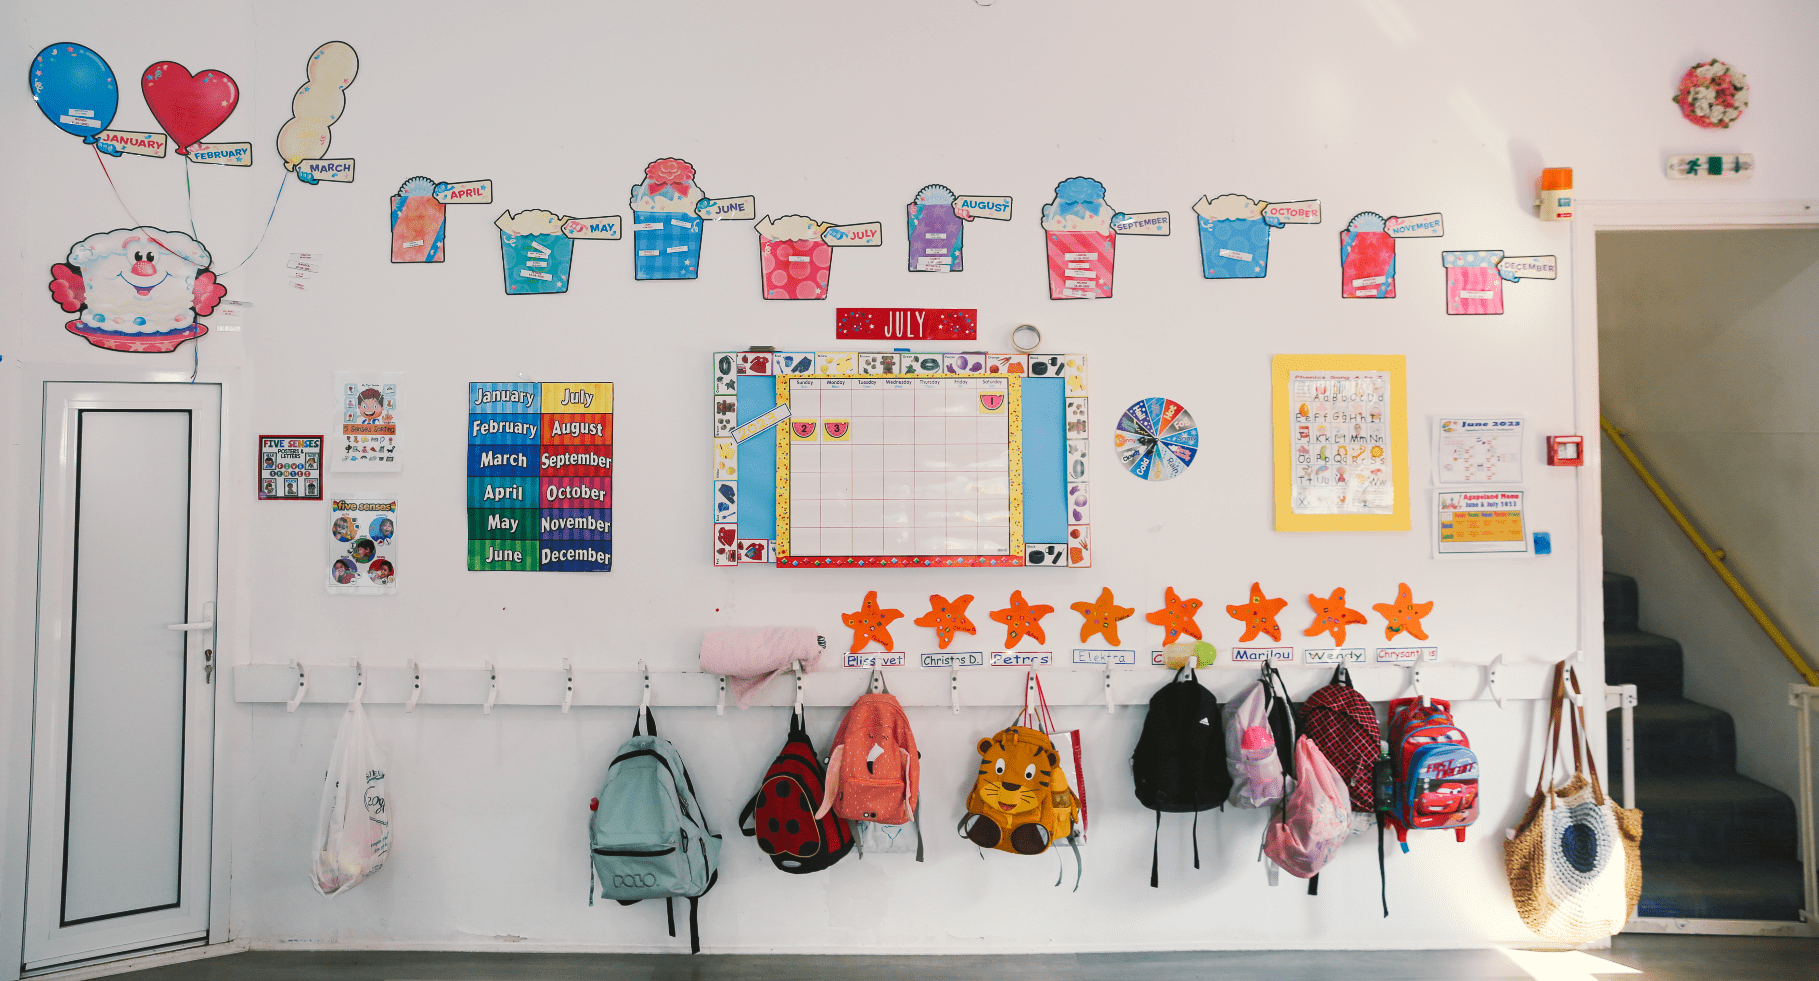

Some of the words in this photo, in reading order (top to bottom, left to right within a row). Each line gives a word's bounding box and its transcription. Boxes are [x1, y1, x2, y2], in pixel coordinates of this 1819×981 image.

[103, 134, 164, 149] JANUARY
[194, 148, 248, 160] FEBRUARY
[310, 164, 350, 173] MARCH
[450, 188, 482, 199] APRIL
[715, 203, 745, 215] JUNE
[961, 200, 1009, 212] AUGUST
[1270, 208, 1318, 218] OCTOBER
[590, 224, 614, 233] MAY
[1116, 217, 1168, 231] SEPTEMBER
[1393, 220, 1440, 234] NOVEMBER
[850, 230, 877, 240] JULY
[1504, 262, 1554, 272] DECEMBER
[884, 311, 926, 337] JULY
[475, 388, 535, 407] January
[561, 389, 594, 408] July
[991, 397, 993, 405] 1
[1133, 405, 1147, 420] Hail
[1164, 405, 1177, 420] Hot
[374, 425, 395, 433] Sorting
[472, 419, 537, 439] February
[552, 420, 603, 437] August
[739, 412, 777, 440] 2023
[1174, 416, 1191, 430] Fog
[480, 450, 527, 468] March
[541, 452, 612, 470] September
[1136, 458, 1150, 475] Cold
[1167, 457, 1179, 474] Rain
[484, 484, 523, 502] April
[546, 485, 606, 502] October
[338, 500, 358, 511] five
[358, 502, 391, 511] senses
[488, 514, 519, 533] May
[541, 516, 610, 533] November
[485, 546, 522, 563] June
[541, 548, 611, 565] December
[847, 655, 902, 666] Elissvet
[970, 655, 979, 664] D.
[613, 873, 656, 888] POLO
